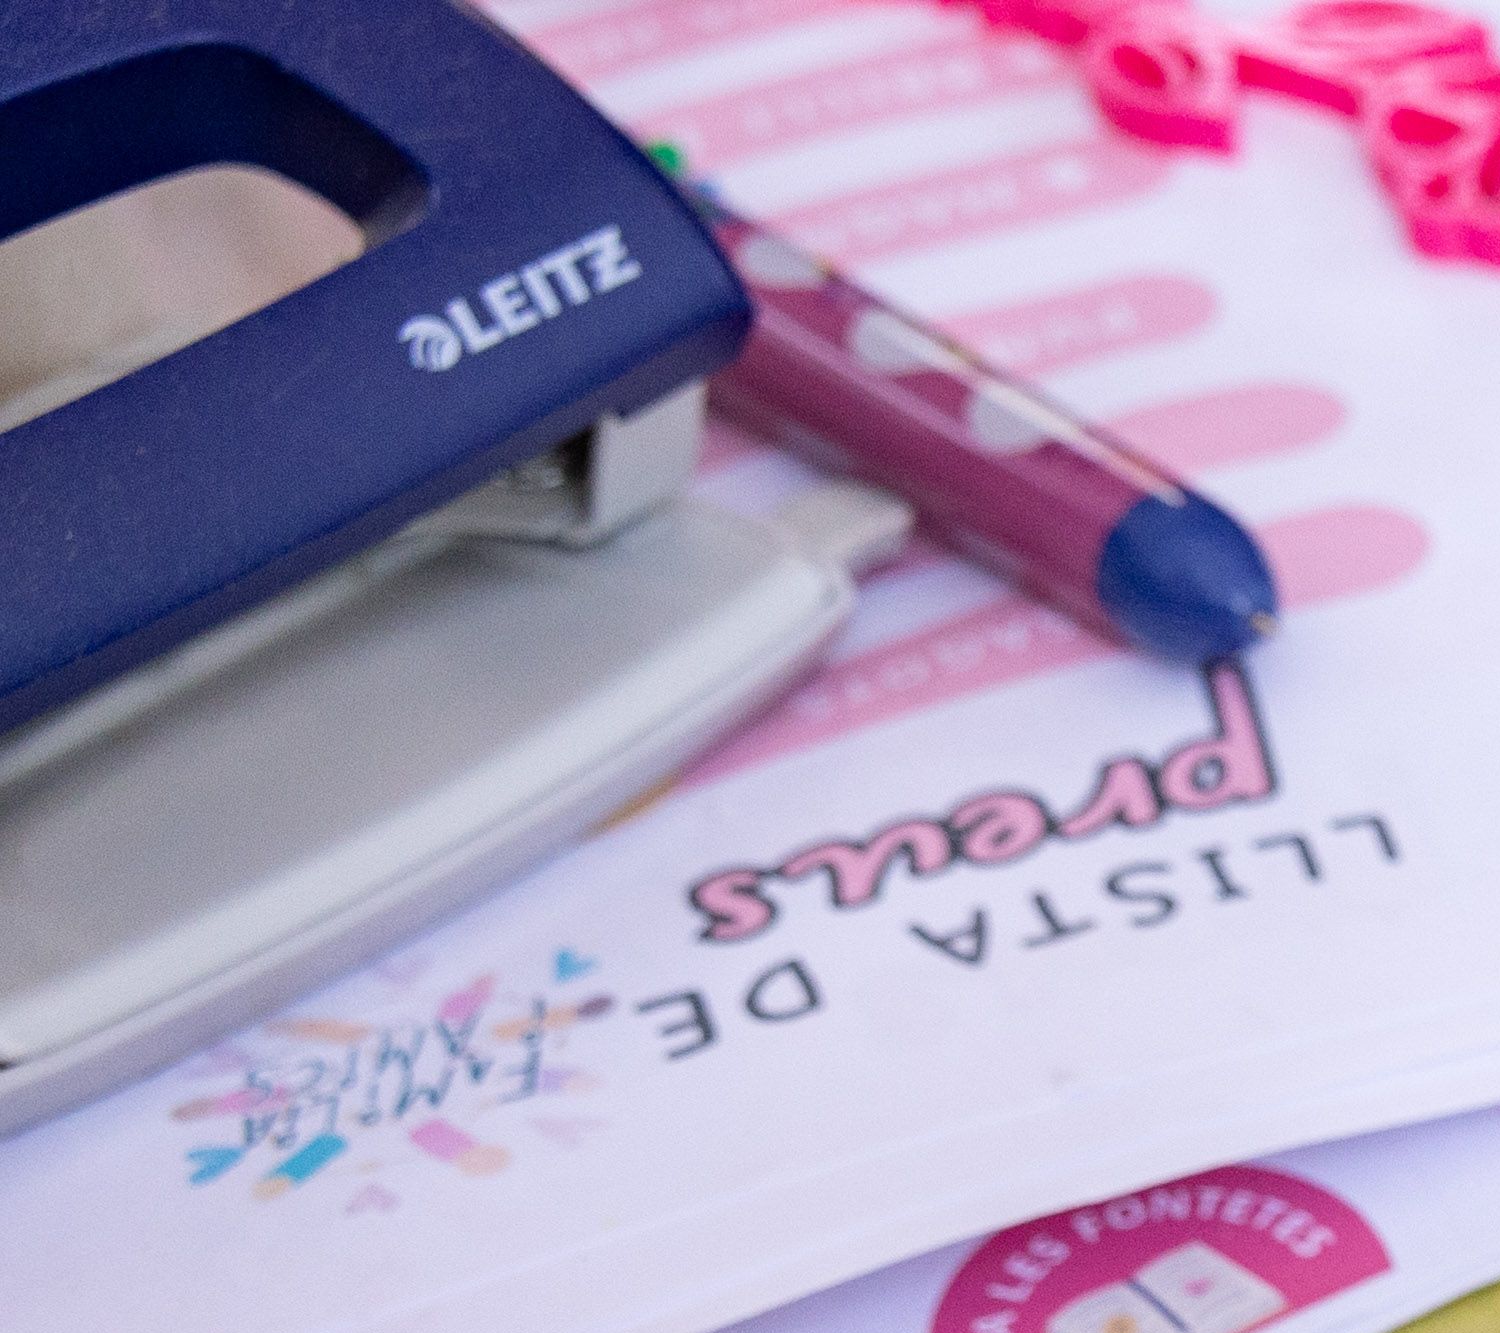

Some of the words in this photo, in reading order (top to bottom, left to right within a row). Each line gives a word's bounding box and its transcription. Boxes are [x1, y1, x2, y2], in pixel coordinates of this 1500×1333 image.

[448, 224, 641, 354] LEITZ
[688, 657, 1279, 943] preus
[911, 811, 1401, 966] LLISTA
[636, 957, 825, 1061] DE
[1071, 1185, 1337, 1260] FONTETES
